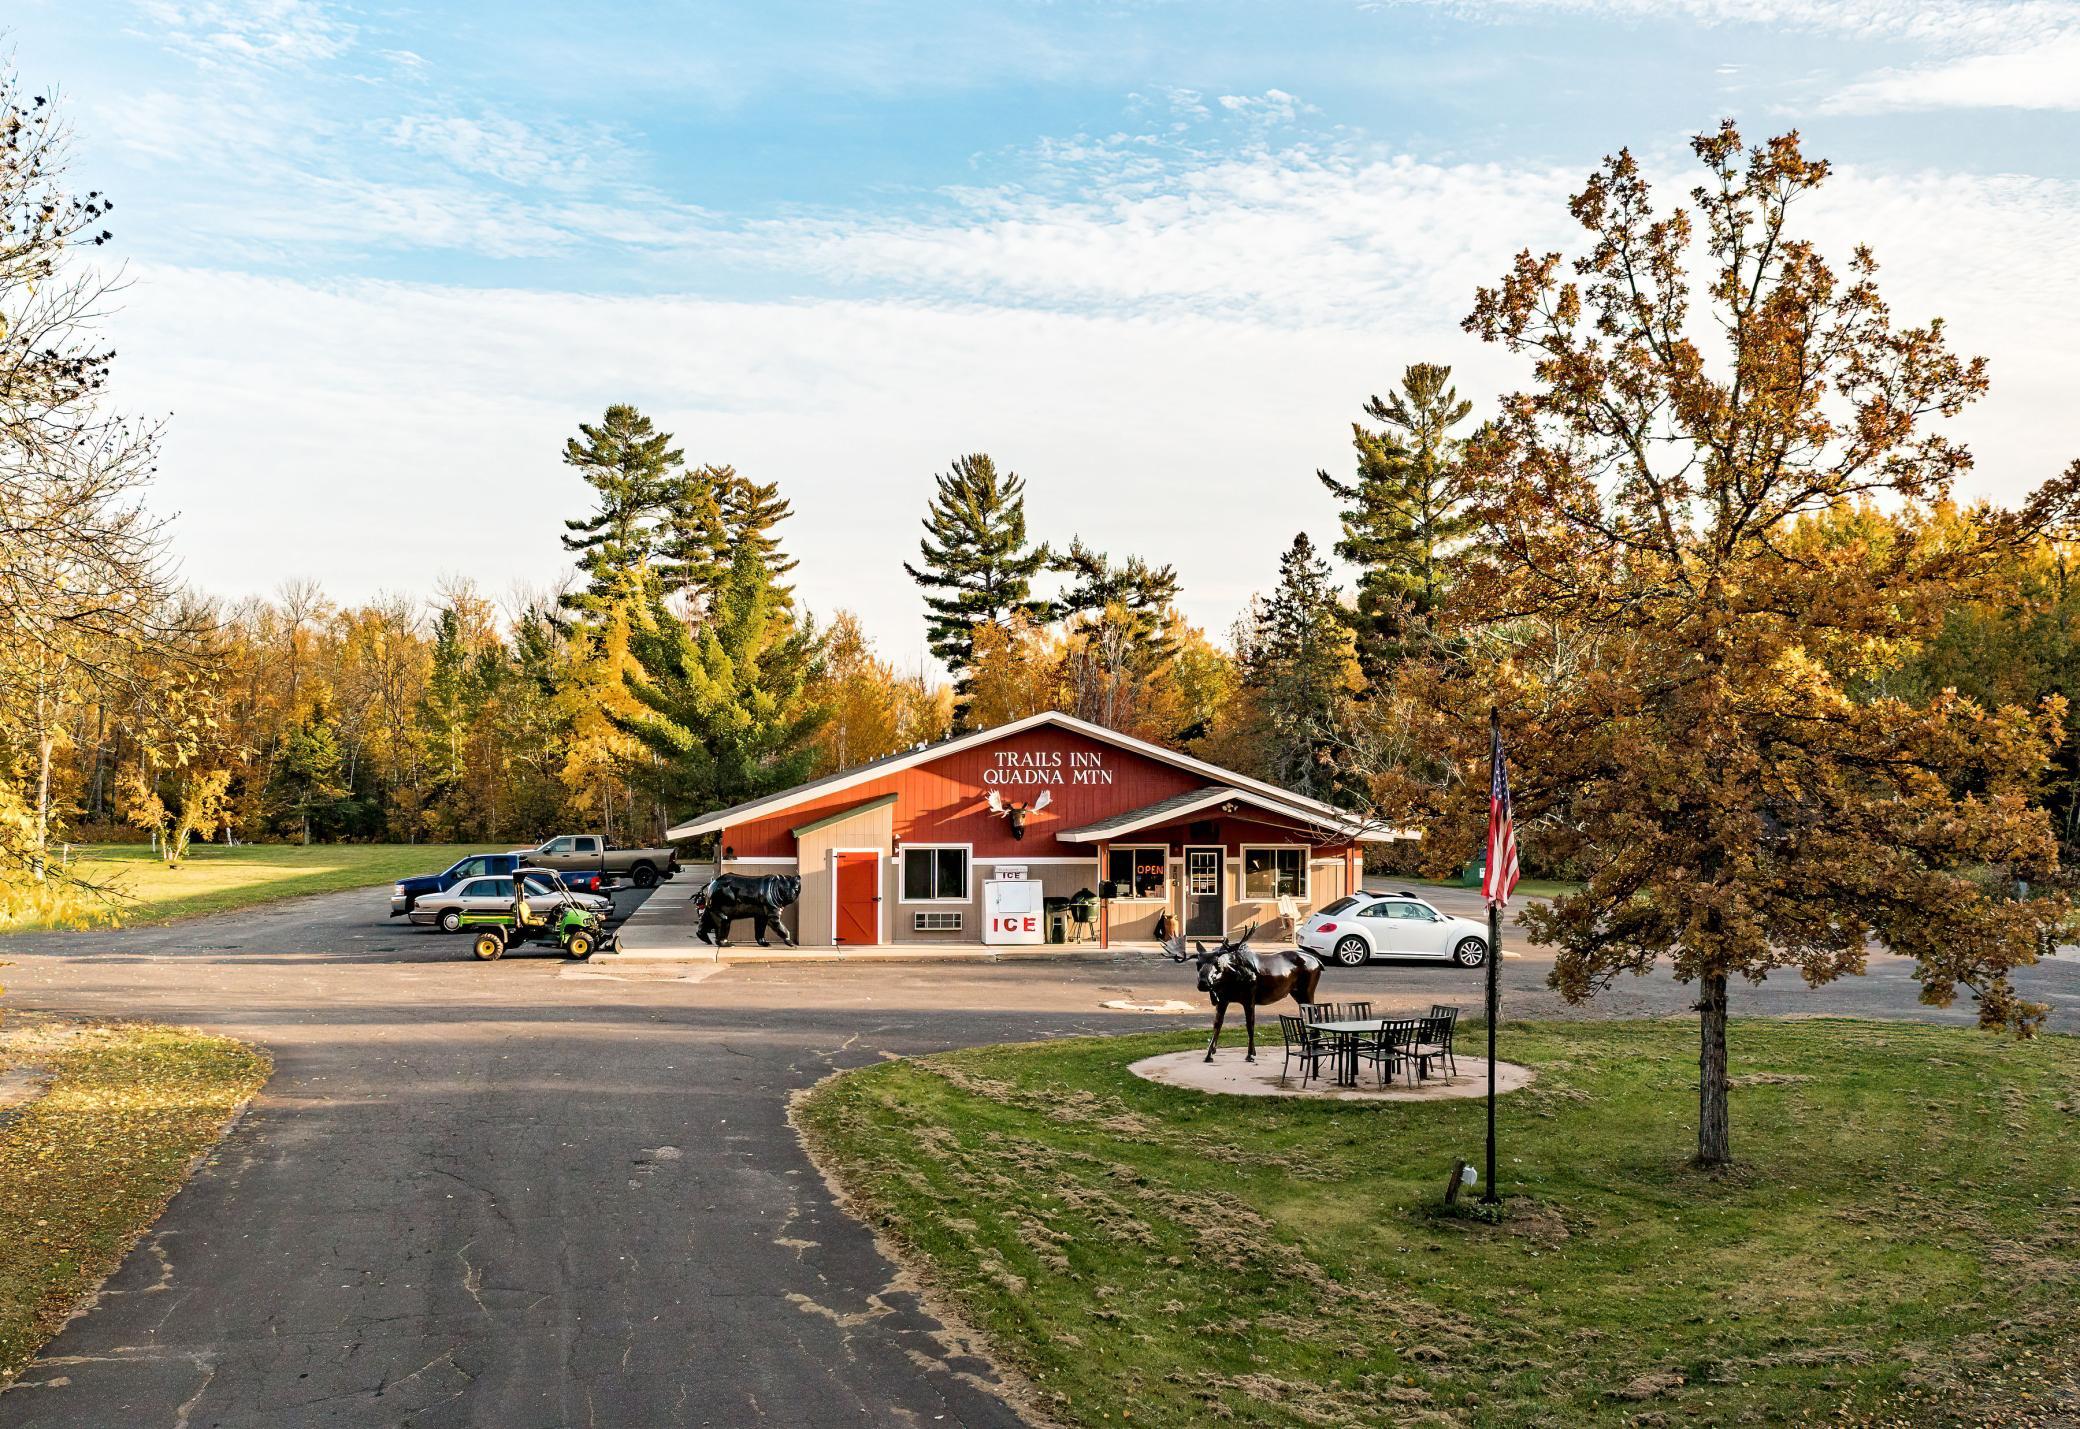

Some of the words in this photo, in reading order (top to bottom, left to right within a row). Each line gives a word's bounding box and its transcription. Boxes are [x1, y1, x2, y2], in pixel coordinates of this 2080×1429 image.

[994, 751, 1062, 767] TRAILS
[1069, 752, 1102, 767] INN
[983, 769, 1065, 785] QUADNA
[1072, 769, 1113, 785] MTN
[1137, 865, 1164, 874] OPEN
[993, 917, 1036, 932] ICE
